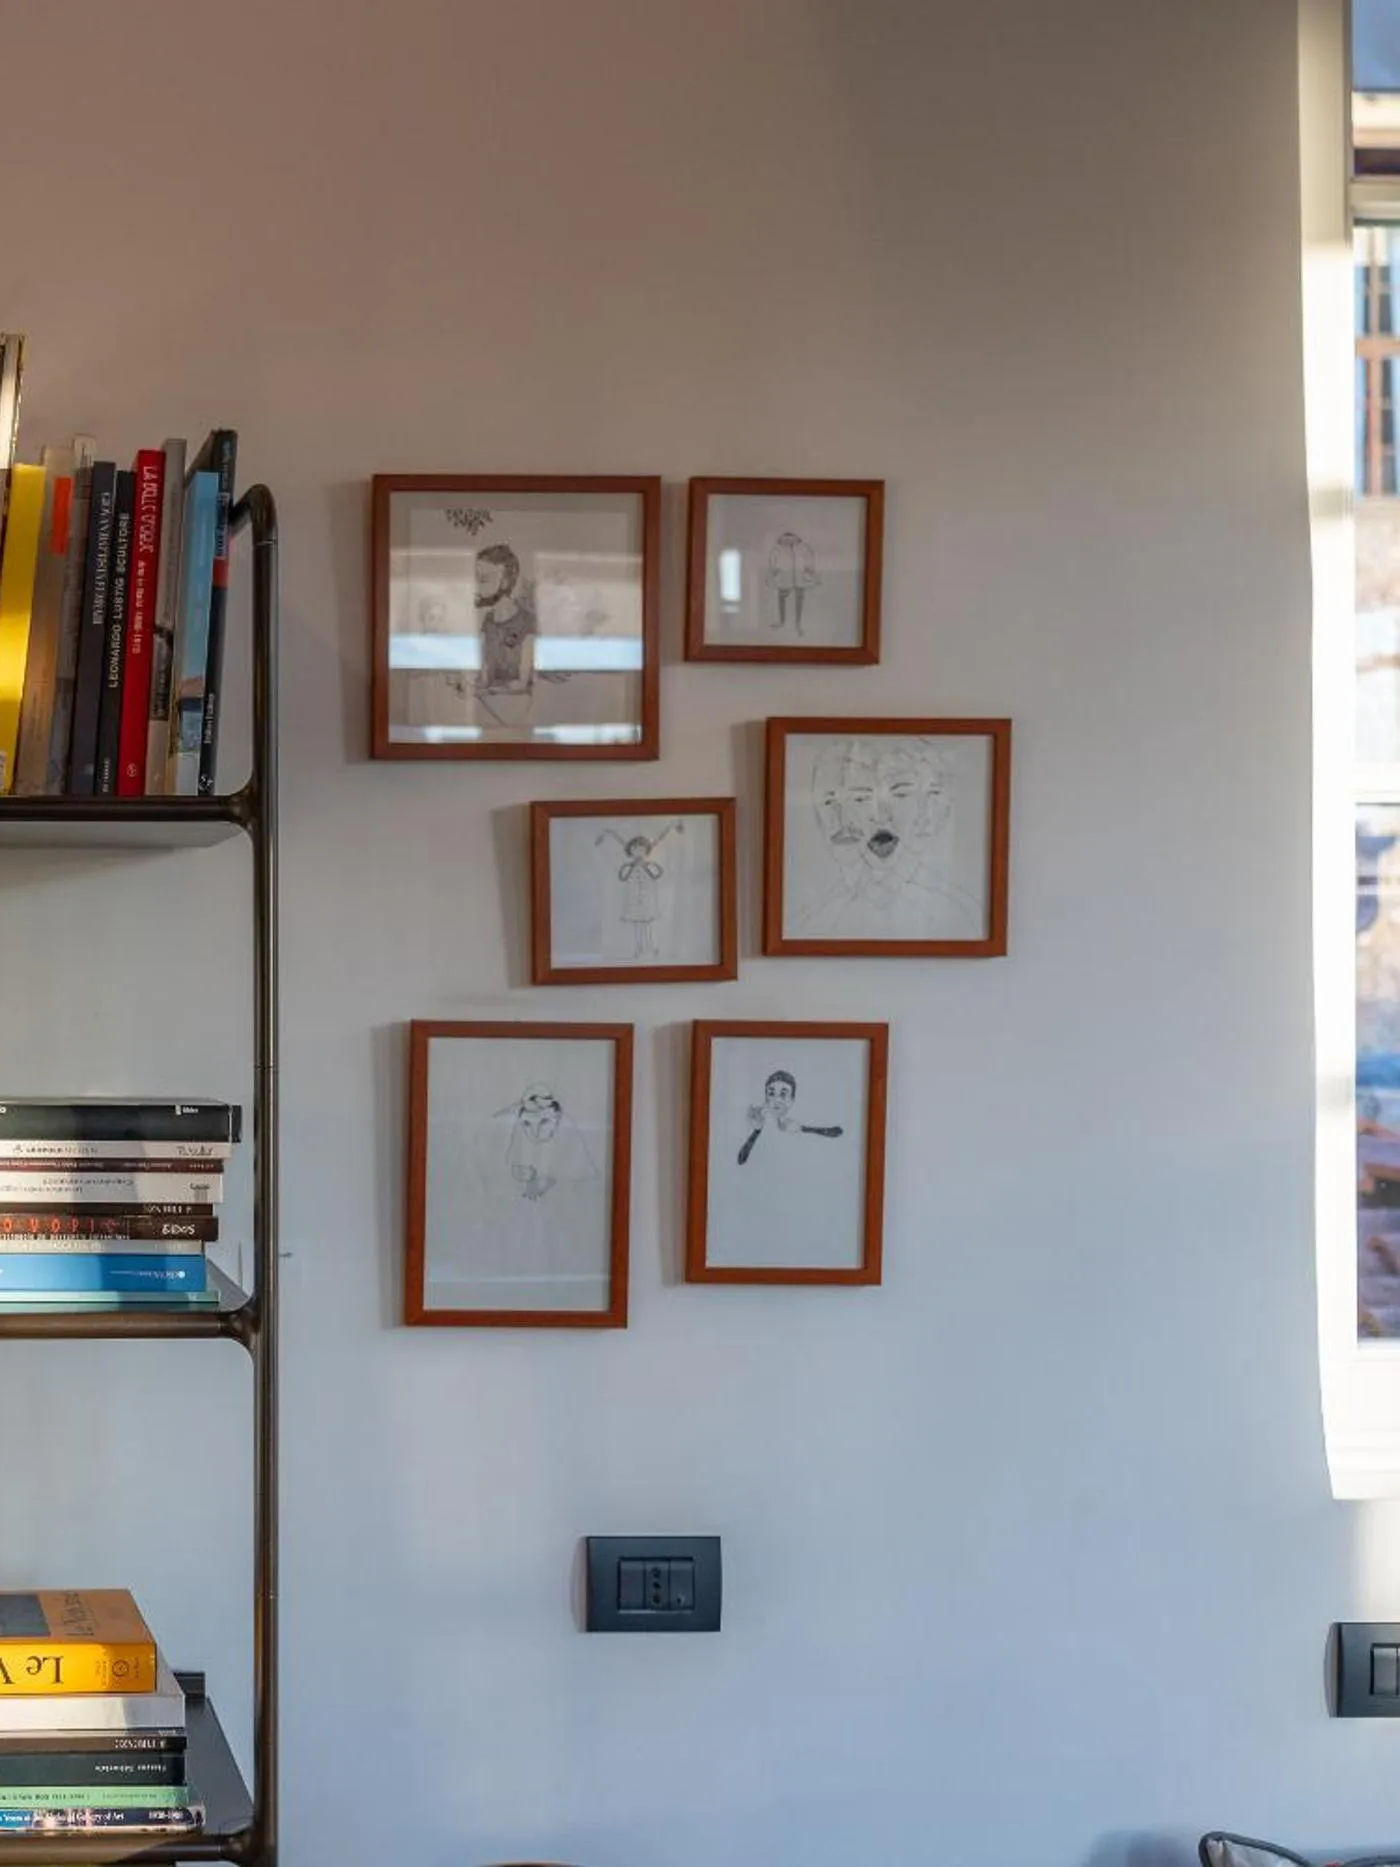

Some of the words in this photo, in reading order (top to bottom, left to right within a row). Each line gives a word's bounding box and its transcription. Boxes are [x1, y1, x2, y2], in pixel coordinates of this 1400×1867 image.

[116, 512, 130, 572] SCULTORE
[112, 577, 125, 619] LUSTIG
[108, 624, 122, 688] LEONARDO
[26, 1656, 65, 1684] Le
